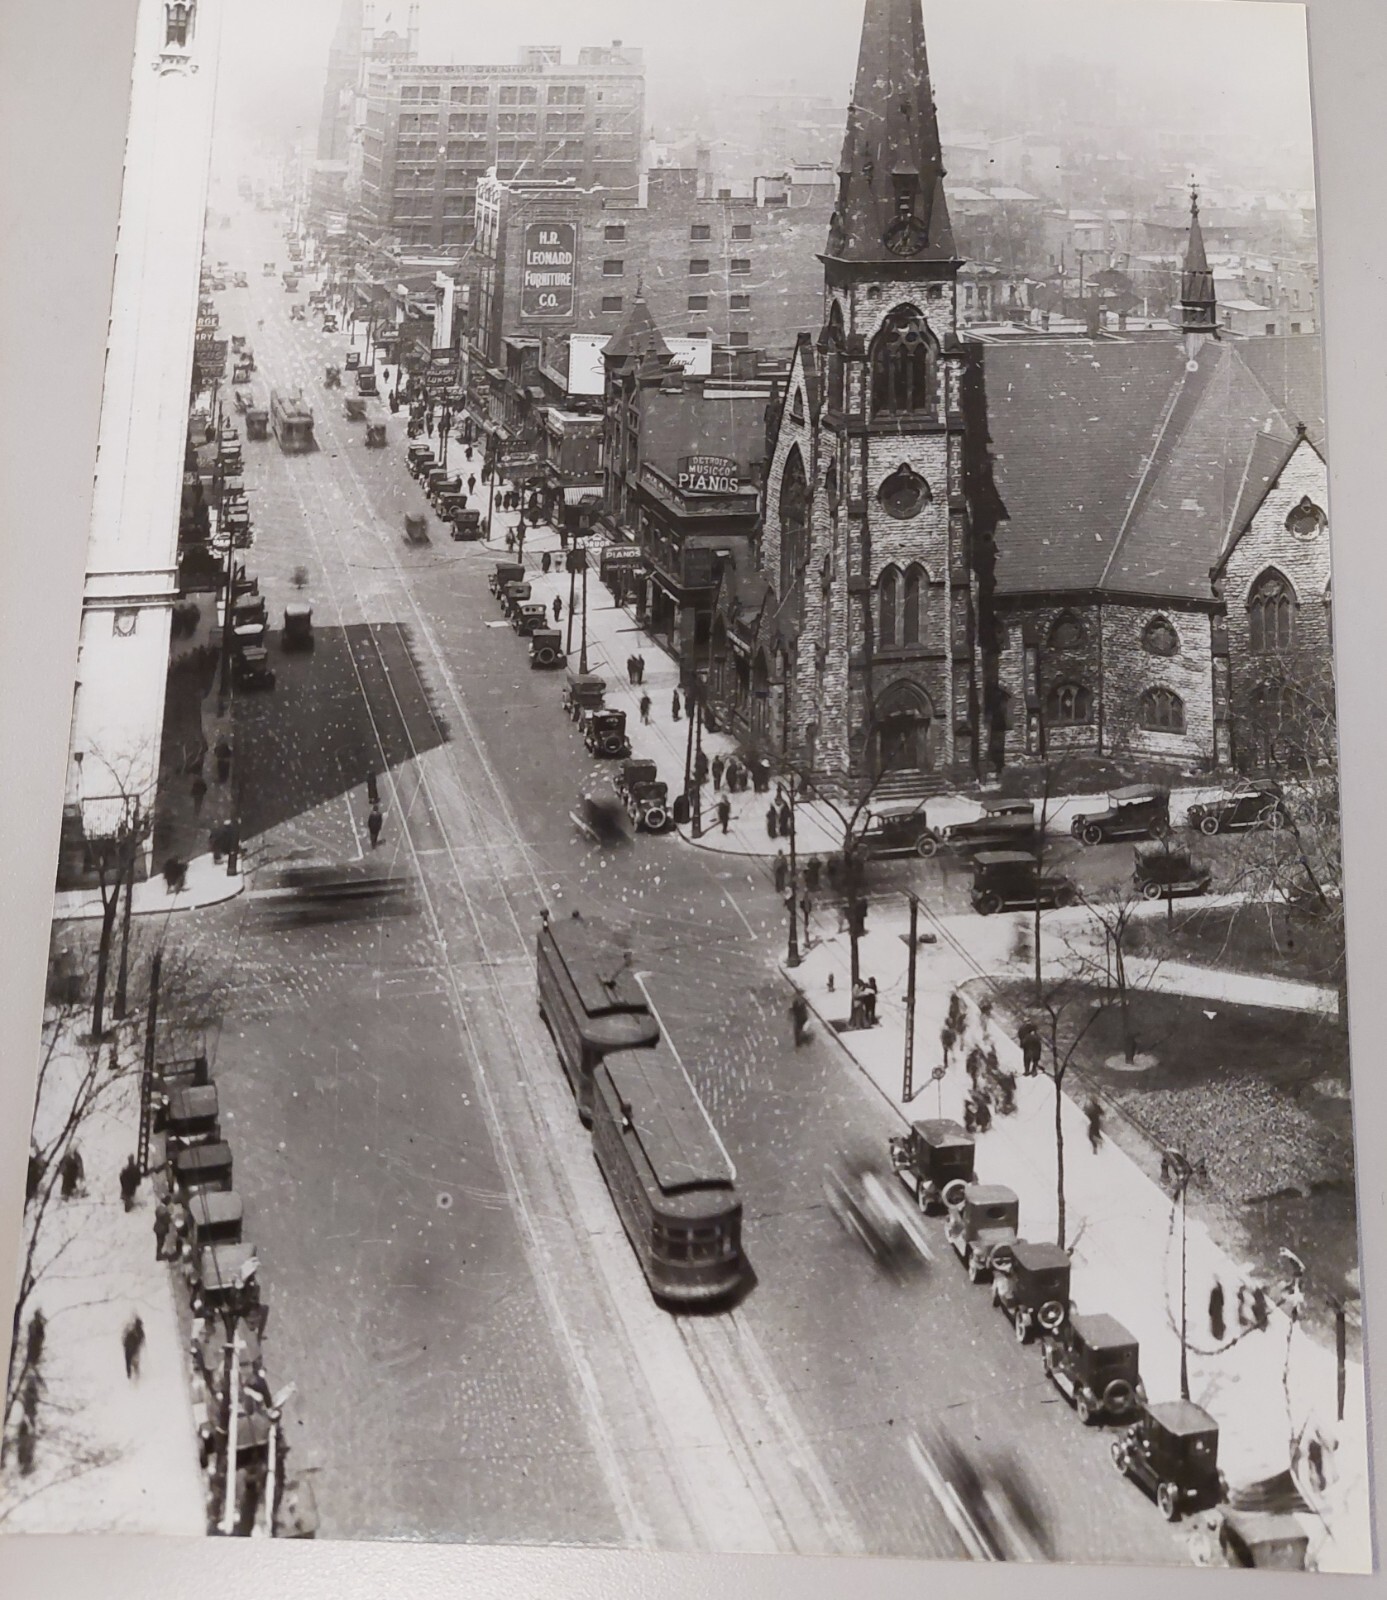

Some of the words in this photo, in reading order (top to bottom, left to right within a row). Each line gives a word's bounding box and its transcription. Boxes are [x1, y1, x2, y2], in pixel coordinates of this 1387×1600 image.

[538, 231, 560, 245] H.R.
[526, 249, 573, 265] LEONARD
[524, 270, 572, 287] FURNITURE
[538, 293, 559, 307] CO.
[692, 456, 729, 467] DETROIT
[678, 472, 739, 493] PIANOS
[606, 550, 642, 559] PIANOS
